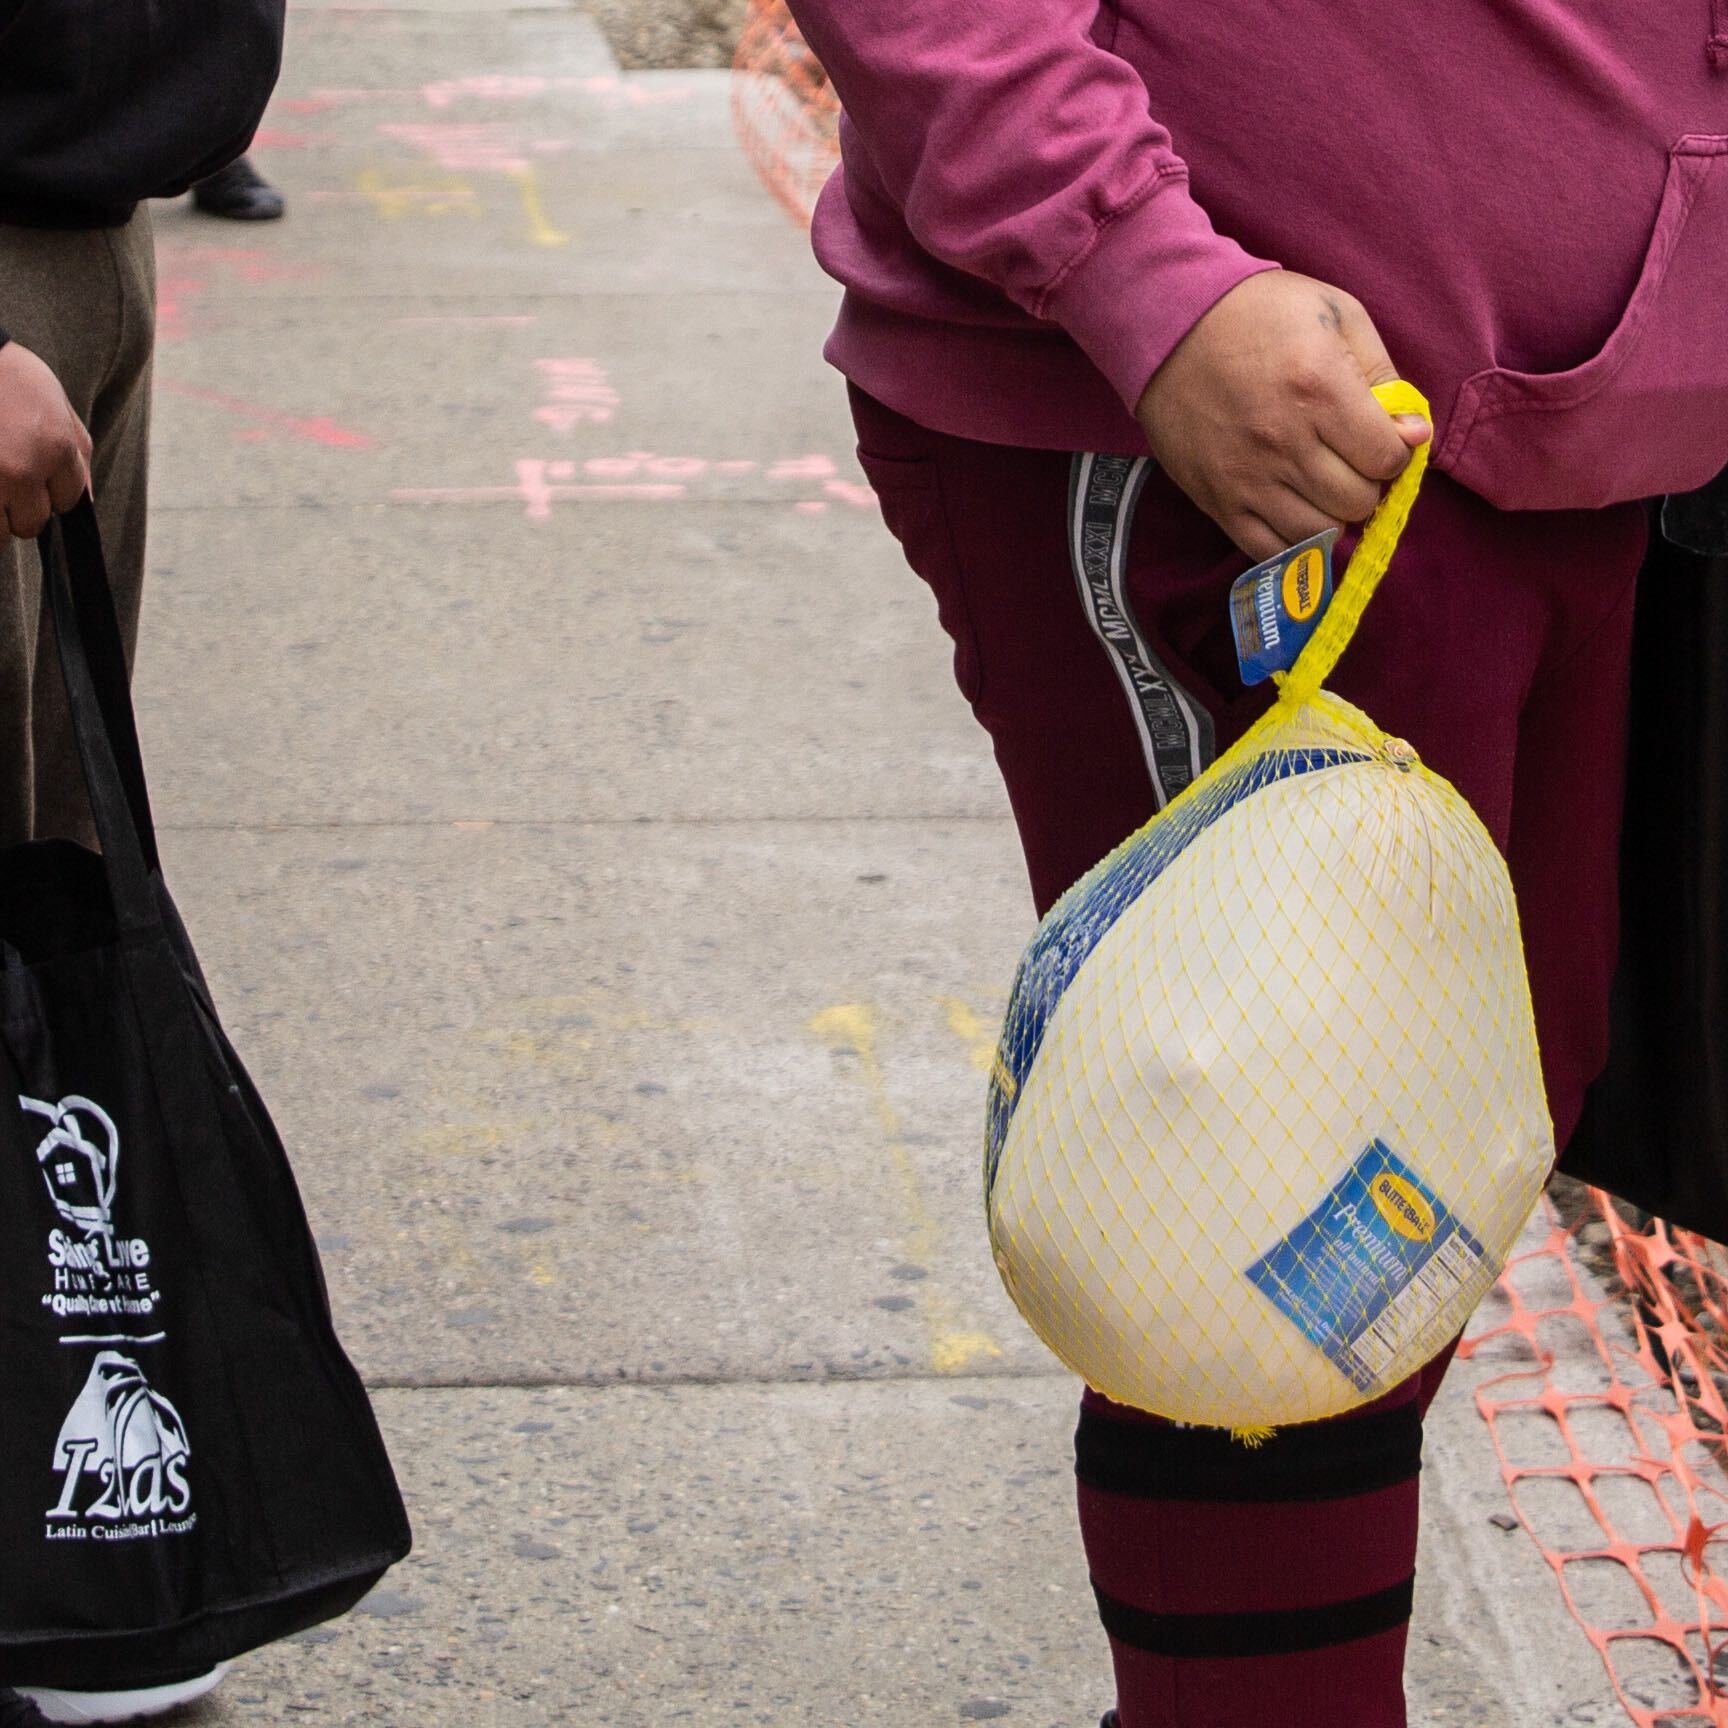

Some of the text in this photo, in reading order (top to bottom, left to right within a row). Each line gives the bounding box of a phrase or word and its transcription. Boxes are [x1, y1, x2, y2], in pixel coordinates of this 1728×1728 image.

[1258, 564, 1282, 650] Premium
[1379, 1179, 1430, 1235] BUTTERBALL
[1334, 1202, 1408, 1281] Premium
[45, 1524, 87, 1539] Latin
